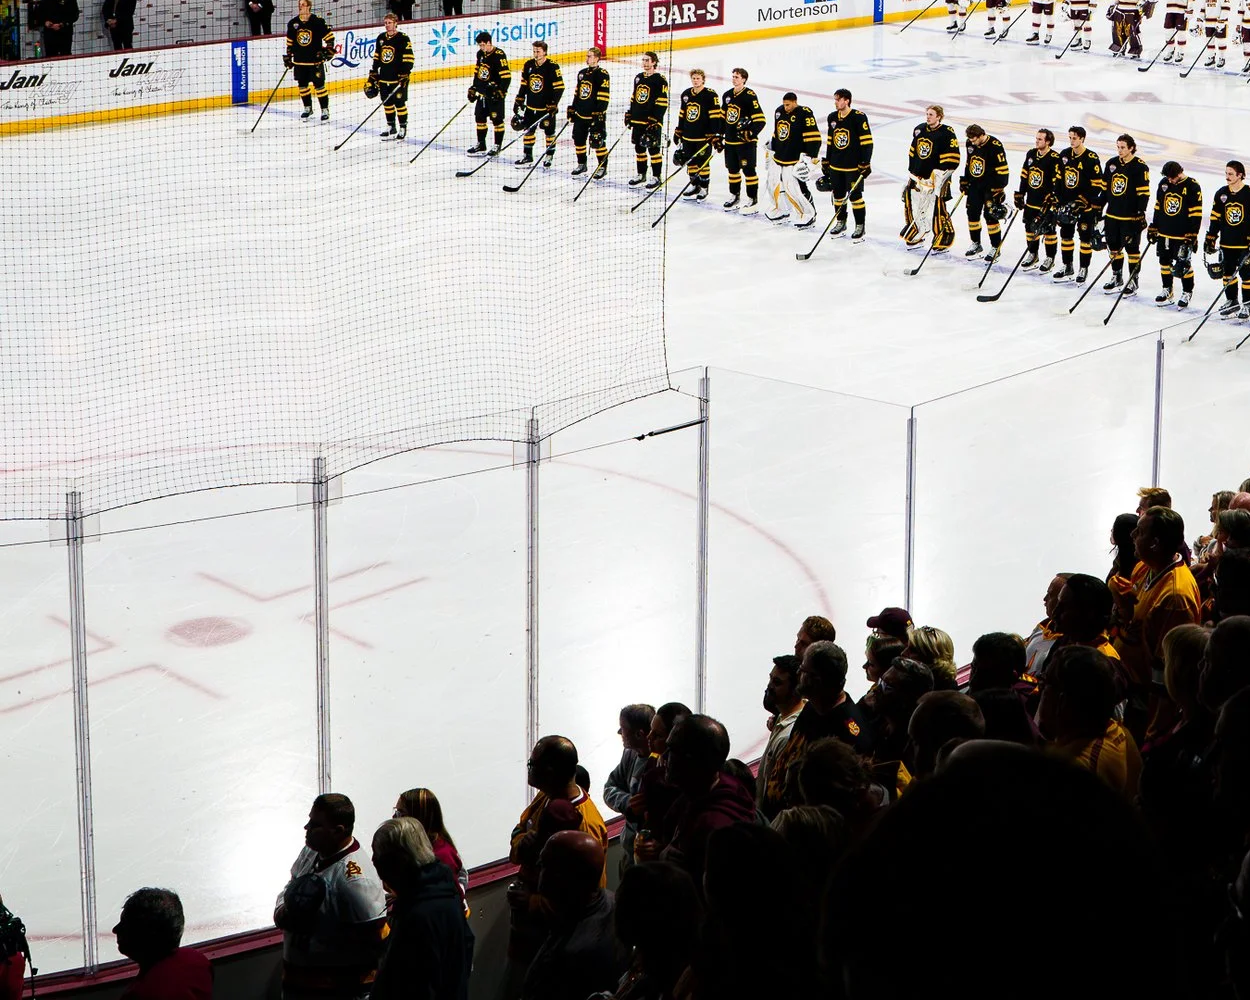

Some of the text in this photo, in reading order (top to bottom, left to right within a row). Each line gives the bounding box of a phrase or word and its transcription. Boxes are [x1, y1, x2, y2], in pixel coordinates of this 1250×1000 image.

[652, 0, 720, 27] BAR-S
[757, 3, 838, 22] Mortenson
[108, 58, 155, 78] Jani
[0, 70, 48, 91] Jani
[753, 100, 759, 109] 5
[790, 115, 796, 123] C
[805, 118, 815, 126] 33
[1077, 162, 1084, 170] A
[1094, 165, 1100, 174] 9
[1182, 187, 1187, 196] A
